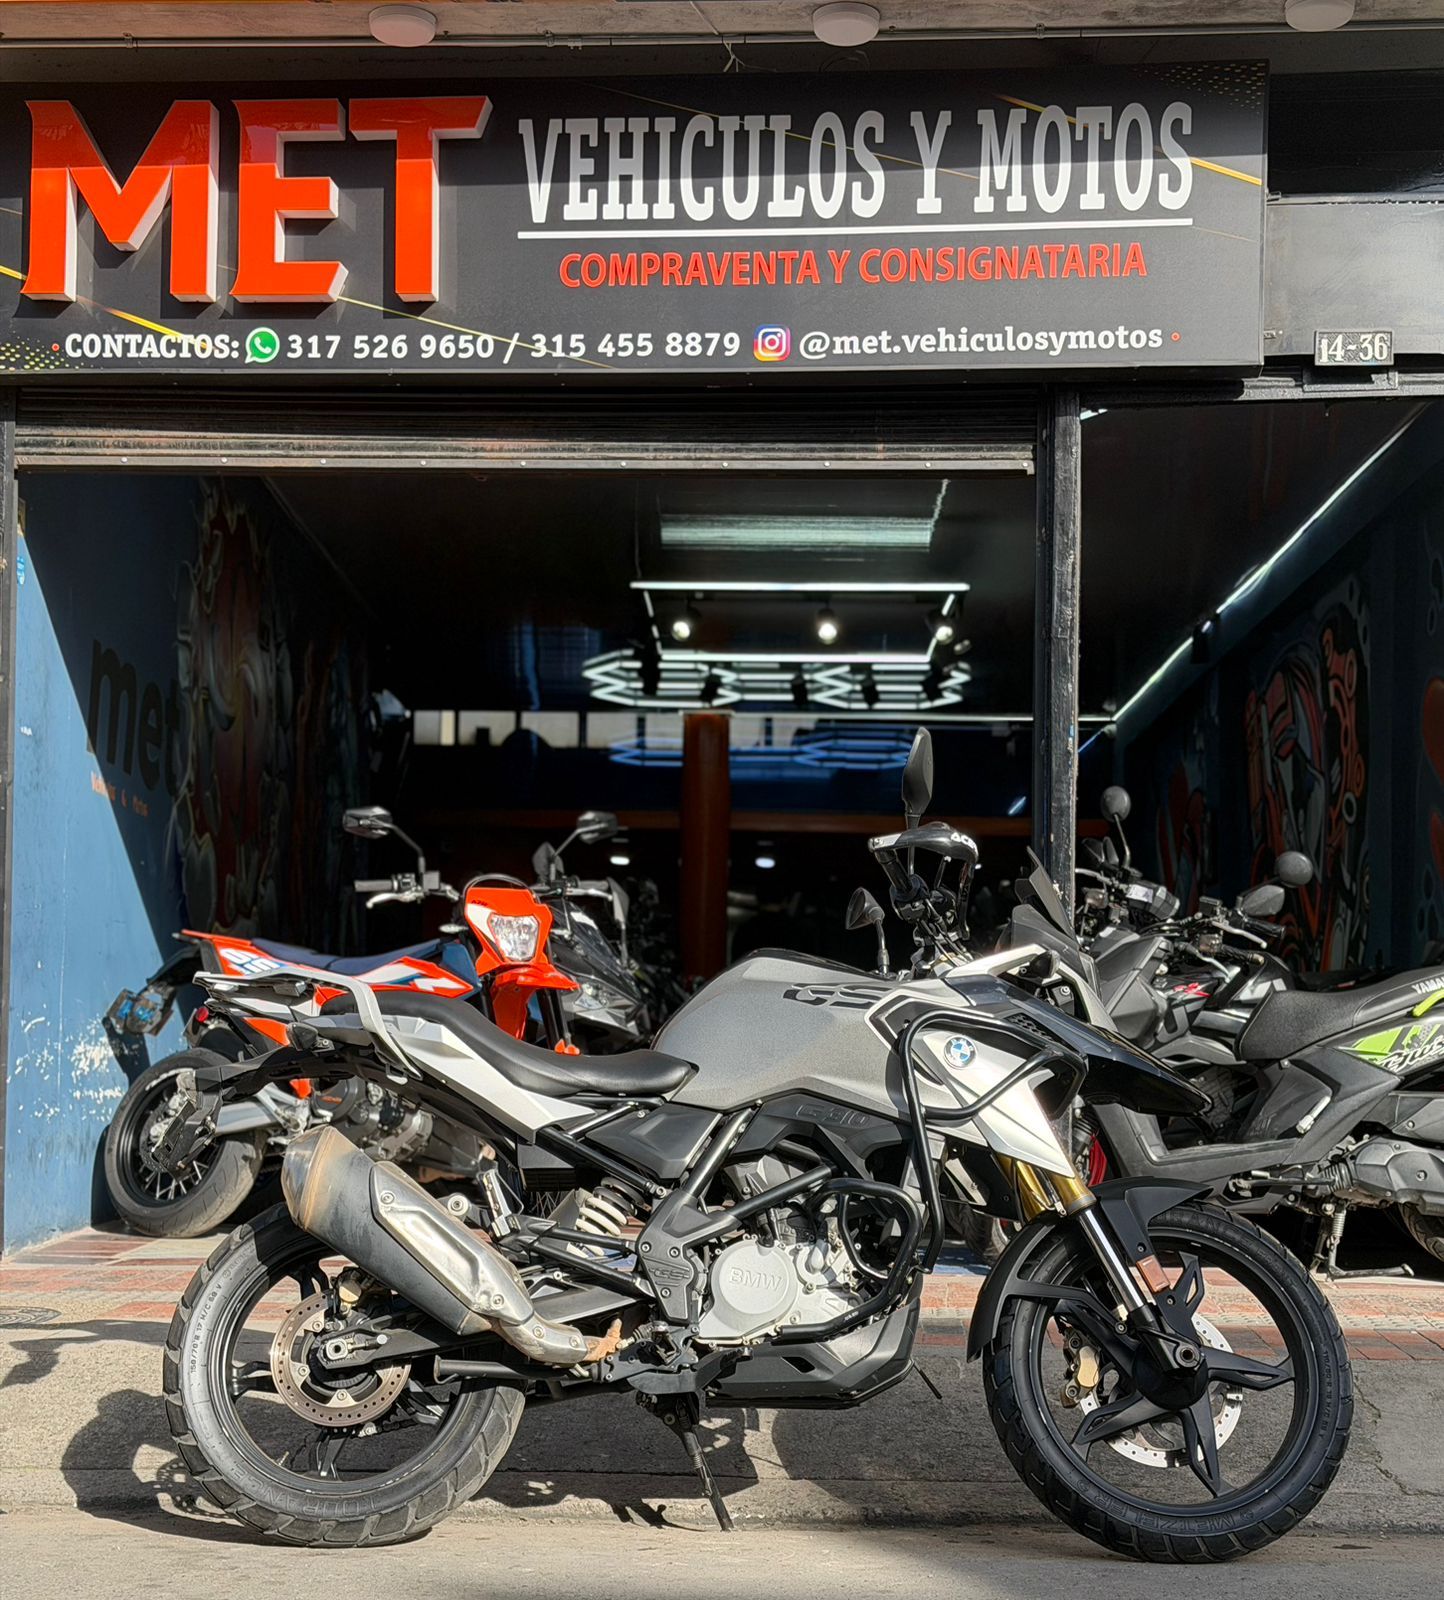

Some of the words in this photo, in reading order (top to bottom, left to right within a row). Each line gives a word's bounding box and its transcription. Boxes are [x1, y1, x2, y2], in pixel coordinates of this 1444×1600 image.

[518, 111, 885, 224] VEHICULOS
[910, 110, 952, 215] Y
[973, 101, 1193, 214] MOTOS
[21, 96, 493, 303] MET
[559, 249, 821, 288] COMPRAVENTA
[826, 249, 851, 284] Y
[859, 241, 1148, 283] CONSIGNATARIA
[64, 332, 241, 360] CONTACTOS:
[286, 334, 338, 359] 317
[353, 334, 408, 359] 526
[420, 333, 495, 359] 9650
[503, 332, 520, 364] /
[530, 333, 587, 359] 315
[597, 333, 654, 358] 455
[665, 331, 741, 357] 8879
[799, 325, 1163, 358] @met.vehiculosymotos
[1319, 333, 1389, 363] 14-36
[1411, 976, 1444, 995] YAMA
[730, 1266, 783, 1292] BMW
[1094, 1494, 1237, 1532] METZELER
